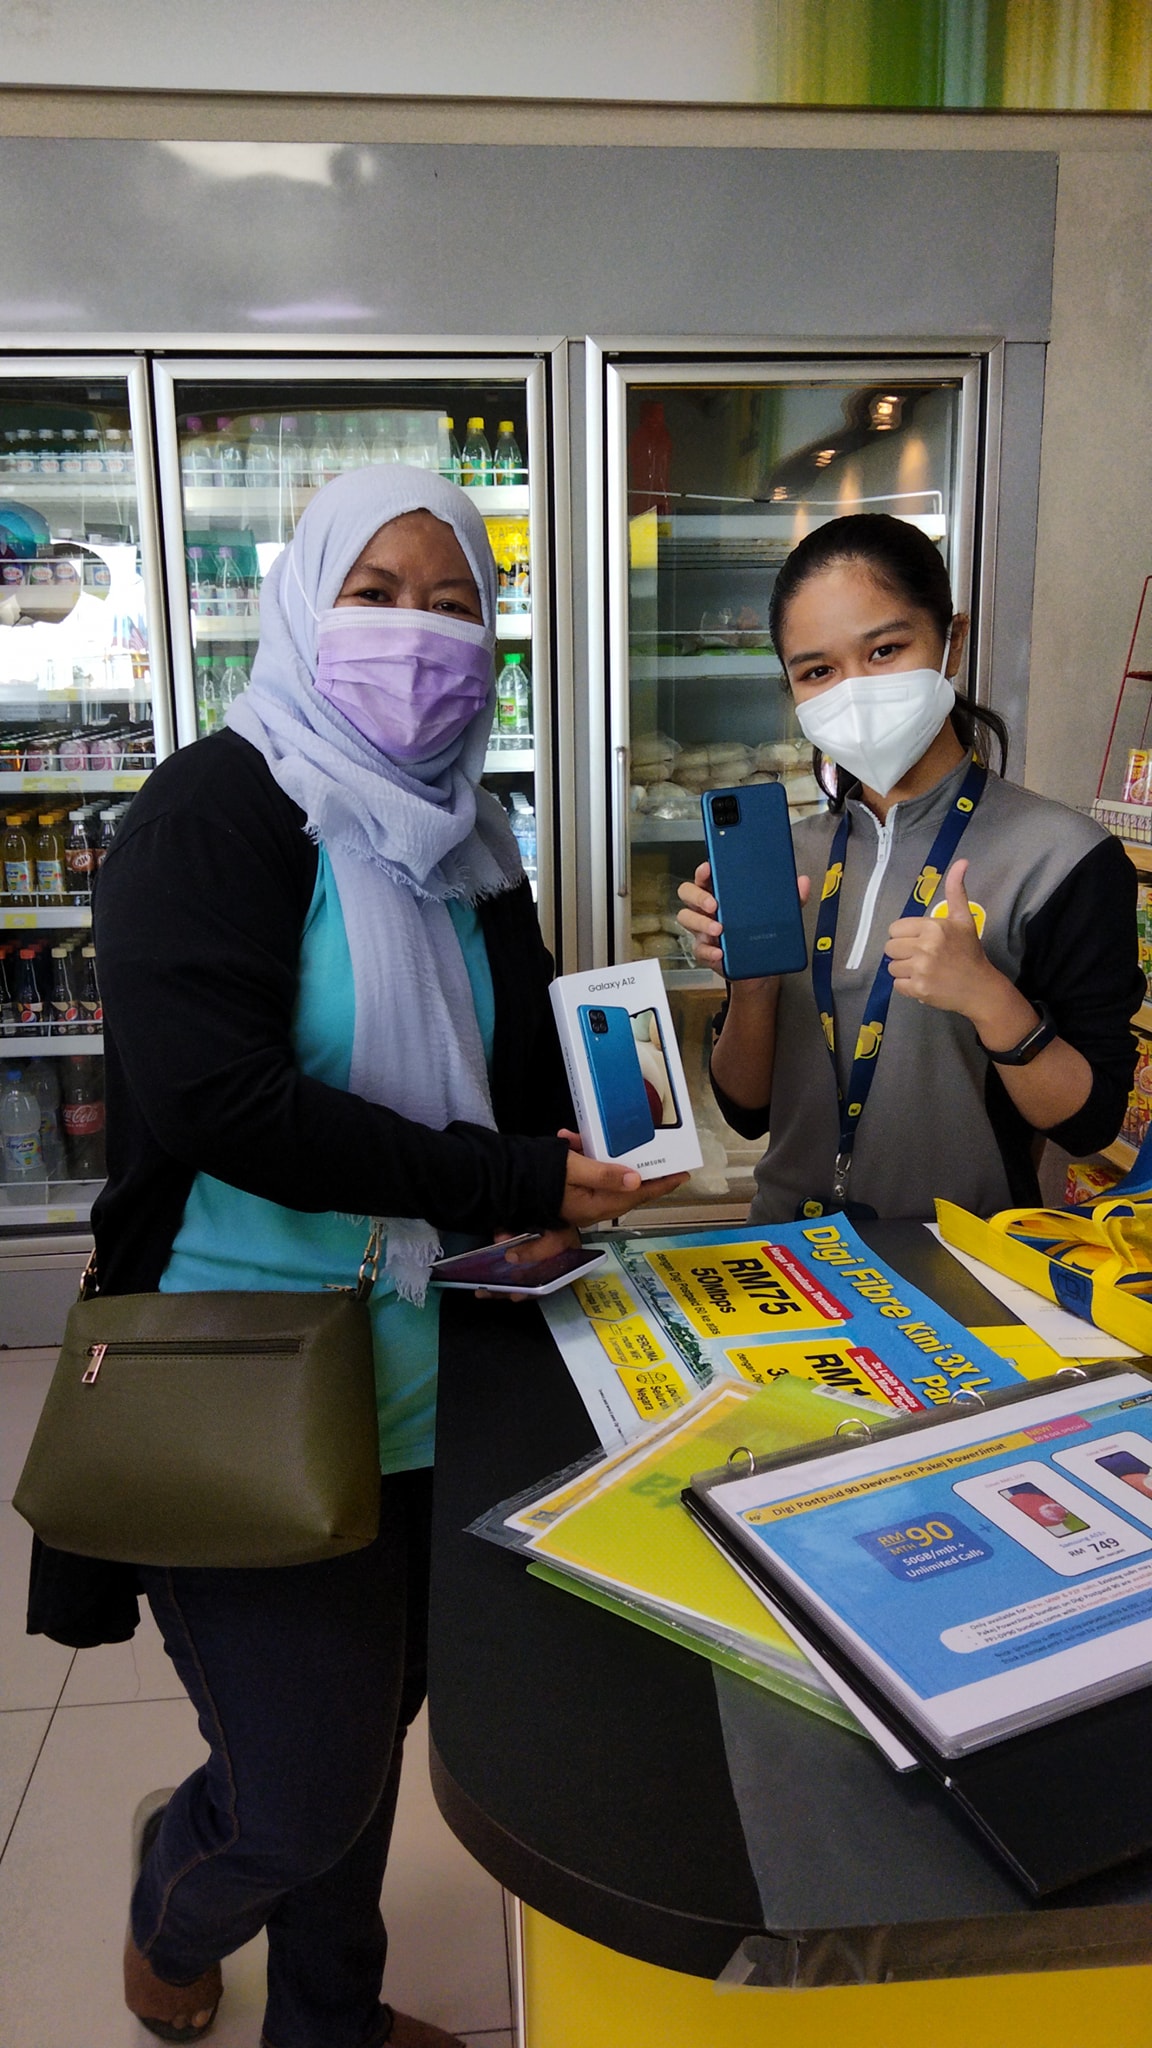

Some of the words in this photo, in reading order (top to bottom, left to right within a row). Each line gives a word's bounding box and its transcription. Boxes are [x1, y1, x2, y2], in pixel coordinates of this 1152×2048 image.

[588, 981, 621, 993] Galaxy
[621, 976, 636, 986] A12
[636, 1157, 666, 1169] SAMSUNG
[690, 1267, 736, 1314] 50Mbps
[721, 1258, 802, 1316] RM75
[802, 1225, 865, 1266] Digi
[840, 1268, 912, 1319] Fibre
[897, 1321, 952, 1354] Kini
[933, 1353, 980, 1379] 3X
[960, 1377, 991, 1395] L
[635, 1387, 654, 1411] Negara
[772, 1503, 795, 1517] Digi
[796, 1490, 844, 1512] Postpaid
[846, 1485, 859, 1496] 90
[859, 1474, 902, 1492] Devices
[903, 1469, 917, 1478] on
[917, 1457, 948, 1475] Pakej
[947, 1443, 1006, 1465] PowerJimat
[876, 1530, 906, 1547] RM
[905, 1520, 954, 1549] 90
[1068, 1548, 1086, 1558] RM
[1087, 1537, 1120, 1553] 749
[889, 1542, 916, 1556] MTH
[902, 1542, 958, 1567] 50GB/mth
[905, 1556, 959, 1578] Unlimited
[958, 1548, 984, 1566] Calls
